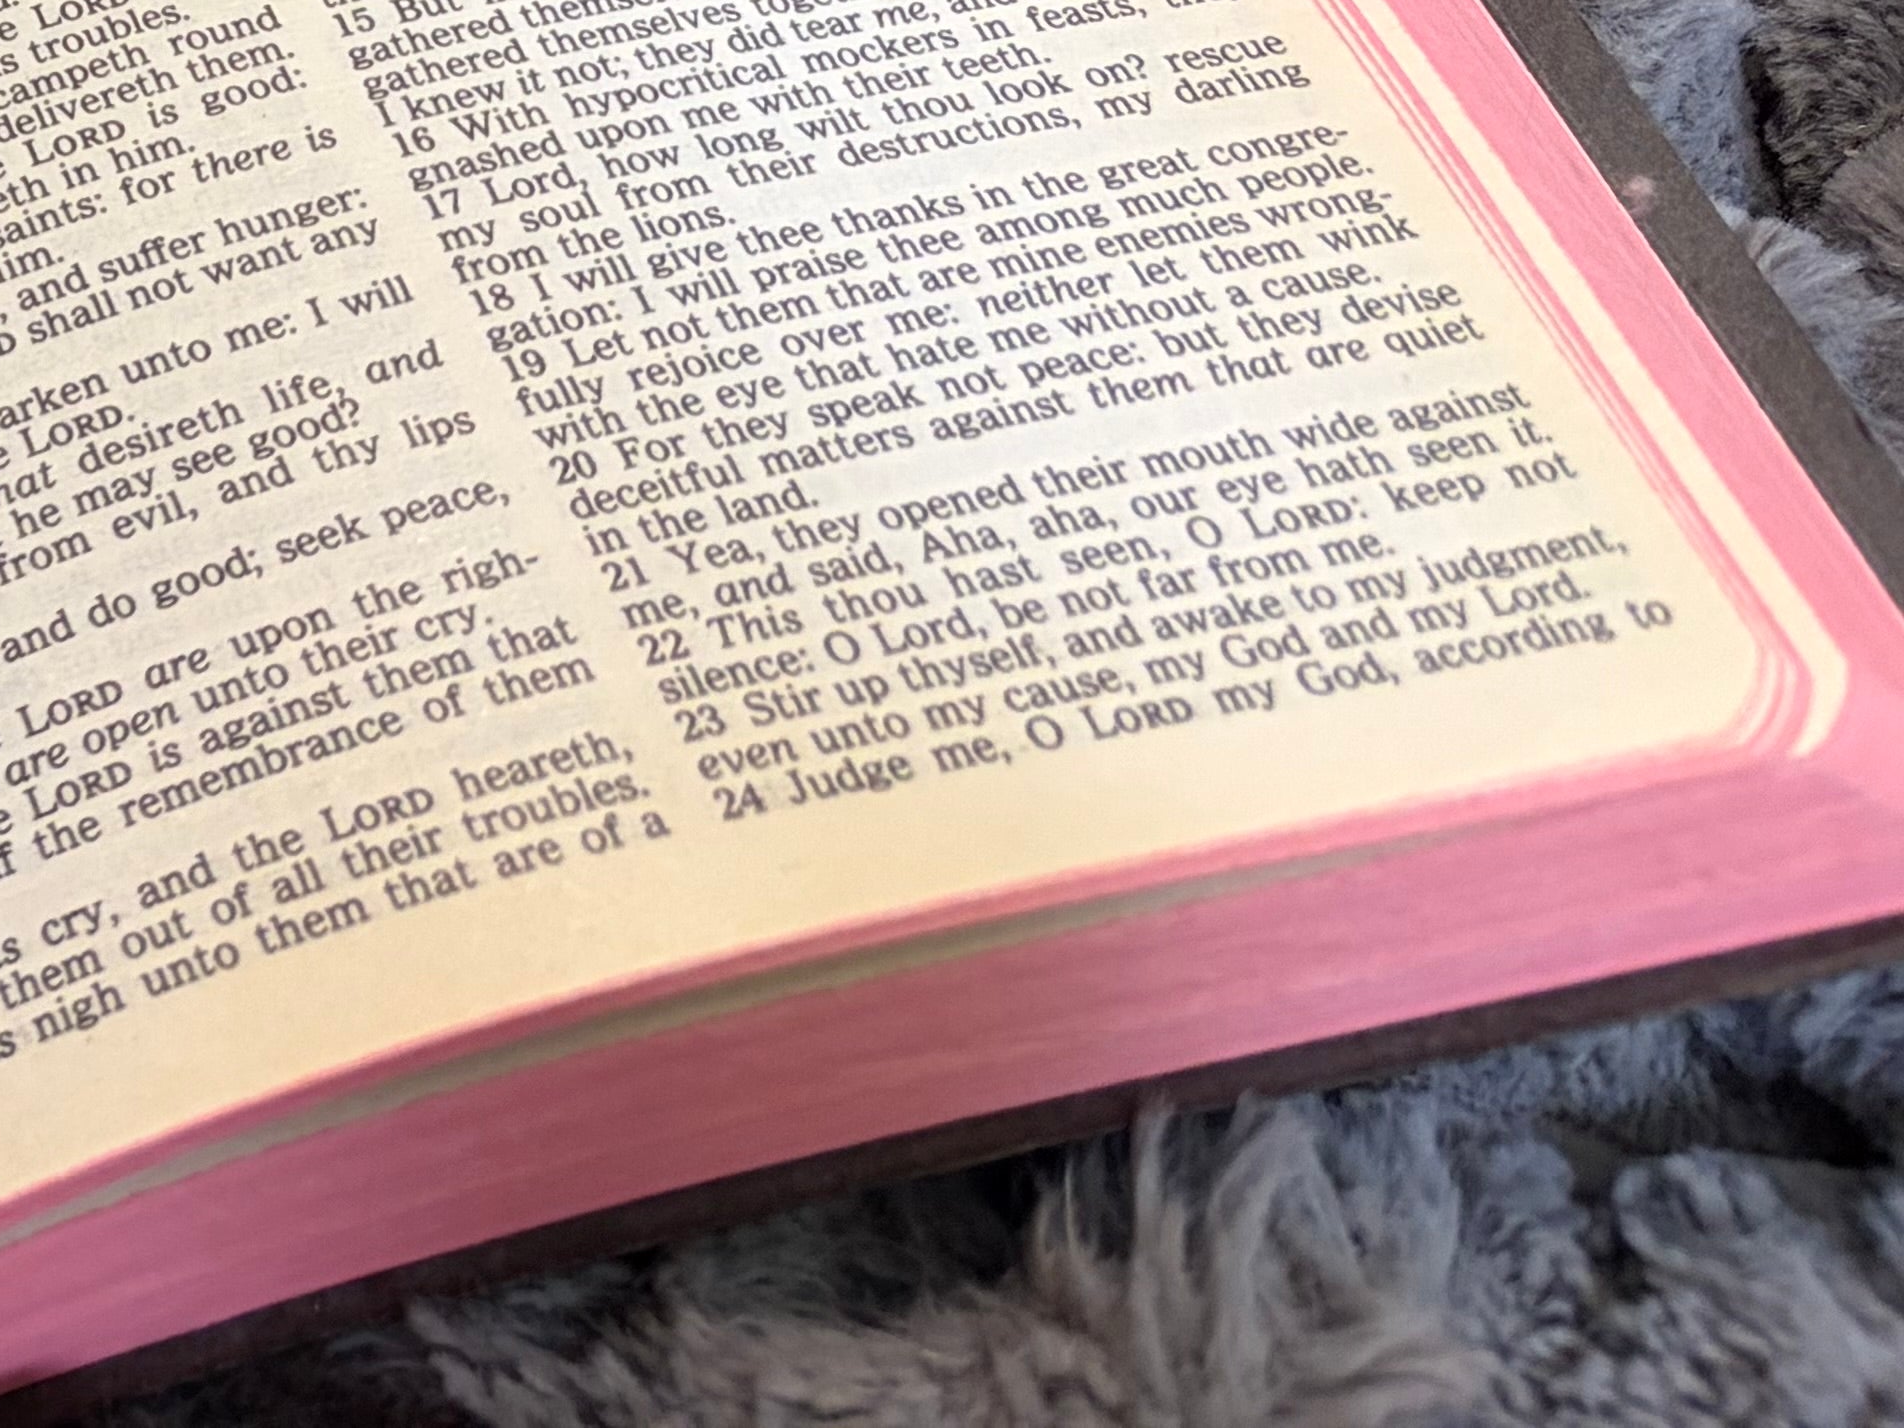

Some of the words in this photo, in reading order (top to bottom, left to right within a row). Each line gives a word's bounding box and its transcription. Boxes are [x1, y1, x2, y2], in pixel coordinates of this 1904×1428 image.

[421, 186, 460, 221] 17
[478, 160, 591, 206] Lord,
[595, 144, 679, 179] how
[693, 127, 784, 160] long
[793, 107, 870, 141] wilt
[880, 91, 975, 125] thou
[981, 69, 1073, 106] look
[1084, 52, 1147, 87] on?
[1162, 34, 1287, 73] rescue
[15, 261, 91, 312] and
[96, 230, 206, 284] suffer
[212, 187, 367, 247] hunger:
[711, 780, 769, 822] 24
[784, 754, 915, 806] Judge
[929, 735, 1013, 773] me,
[1023, 713, 1066, 751] O
[1077, 695, 1195, 741] LORD
[1210, 677, 1275, 715] my
[1294, 649, 1401, 697] God,
[1412, 612, 1616, 675] according
[1624, 599, 1673, 630] to
[30, 980, 127, 1044] nigh
[138, 941, 241, 998] unto
[253, 896, 372, 955] them
[382, 858, 479, 911] that
[492, 837, 565, 880] are
[579, 810, 625, 855] of
[639, 810, 672, 840] a
